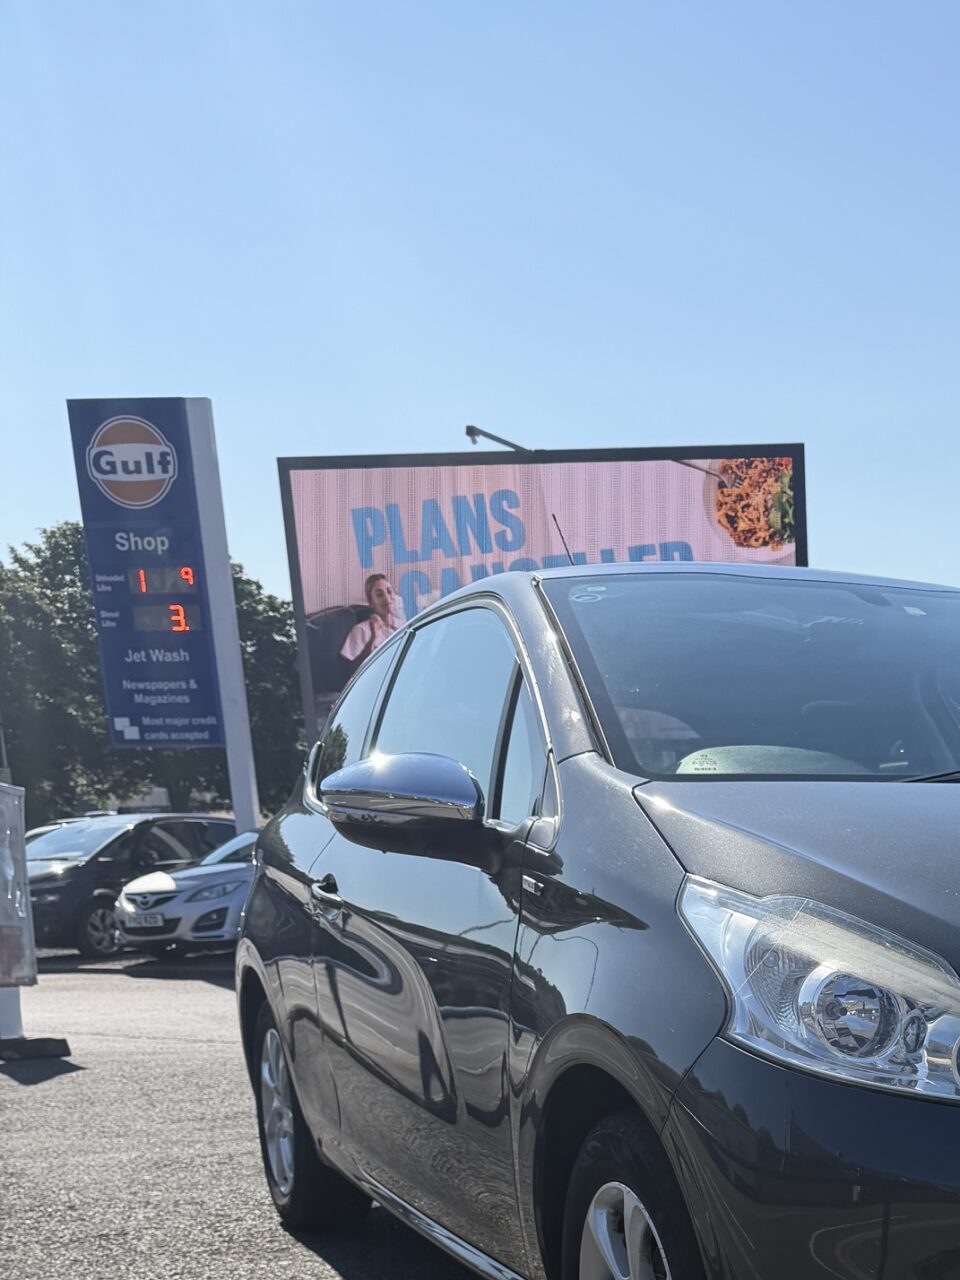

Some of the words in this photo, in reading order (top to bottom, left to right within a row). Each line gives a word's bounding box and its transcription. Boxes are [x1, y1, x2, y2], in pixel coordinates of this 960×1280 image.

[92, 450, 172, 476] Gulf
[351, 489, 526, 568] PLANS
[115, 532, 169, 555] Shop
[125, 649, 147, 662] Jet
[149, 649, 190, 662] Wash
[123, 680, 187, 691] Newspapers
[189, 679, 198, 689] &
[134, 693, 190, 706] Magazines
